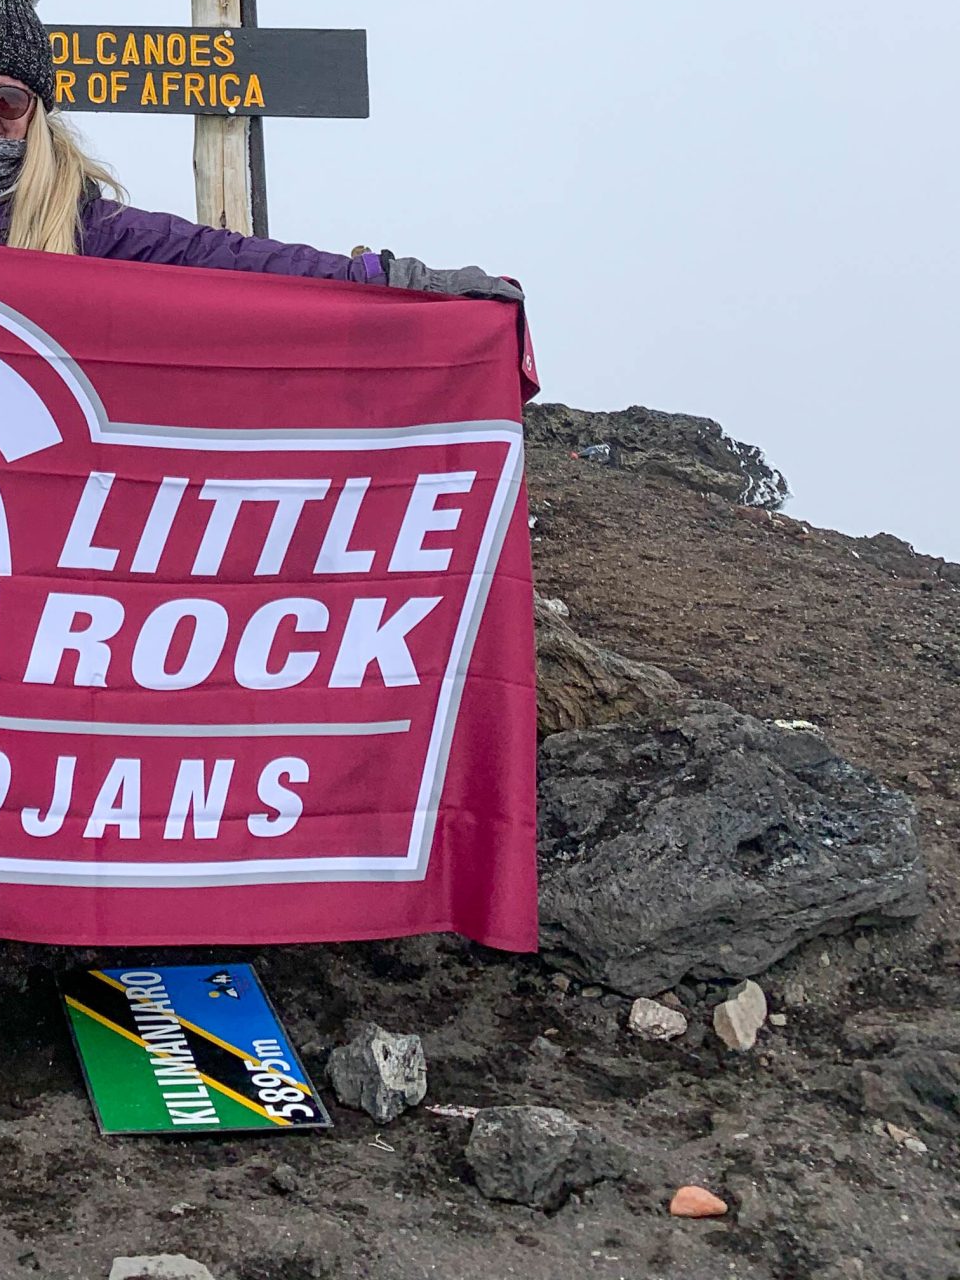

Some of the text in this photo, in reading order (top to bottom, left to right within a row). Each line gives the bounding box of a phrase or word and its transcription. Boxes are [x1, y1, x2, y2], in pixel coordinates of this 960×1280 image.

[49, 32, 234, 67] OLCANOES
[88, 71, 129, 103] OF
[141, 72, 264, 107] AFRICA
[58, 471, 476, 575] LITTLE
[23, 592, 444, 691] ROCK
[121, 973, 219, 1124] KILIMANJARO
[244, 1040, 313, 1117] 5895m
